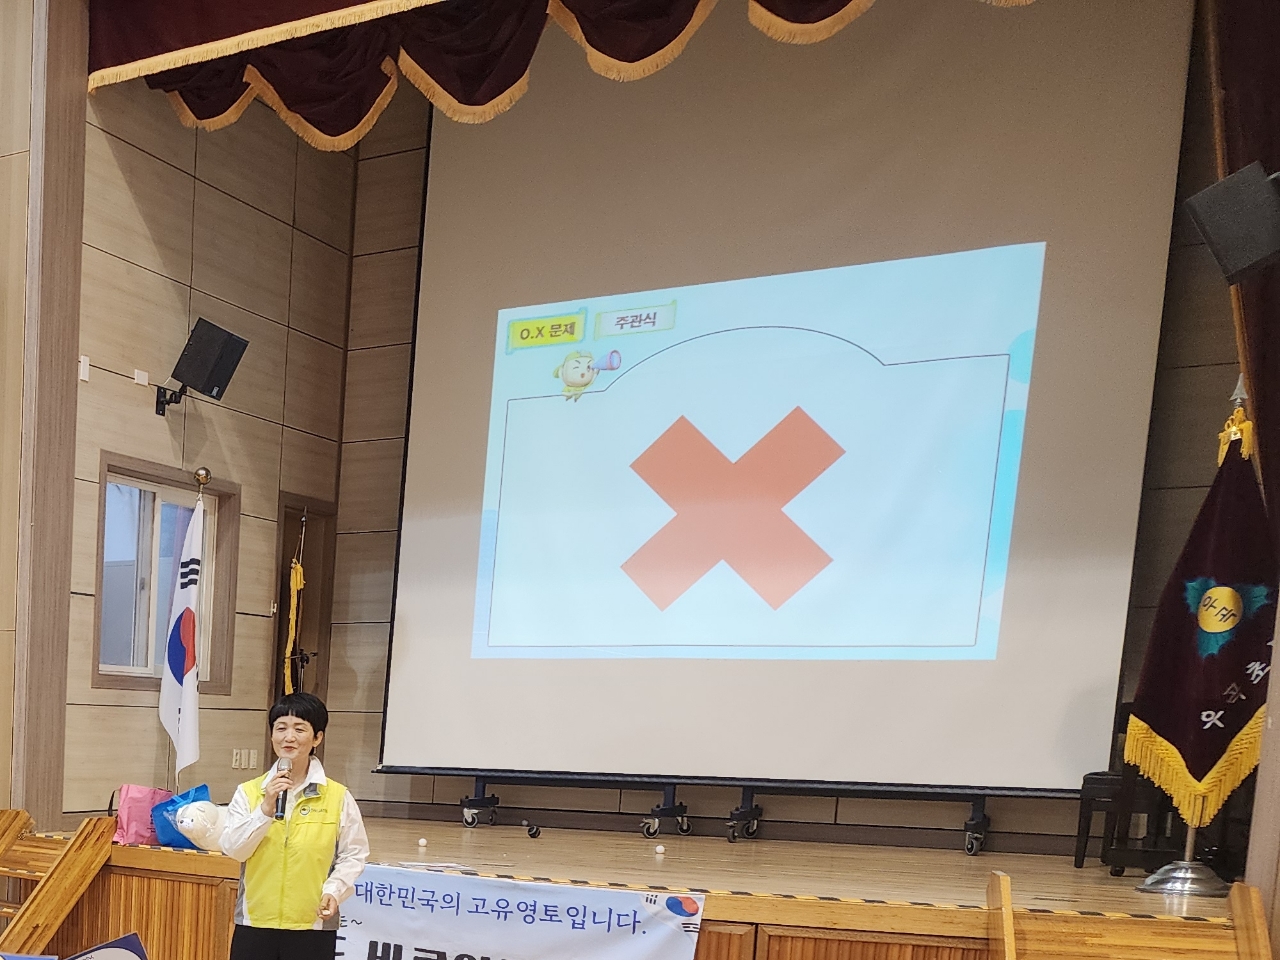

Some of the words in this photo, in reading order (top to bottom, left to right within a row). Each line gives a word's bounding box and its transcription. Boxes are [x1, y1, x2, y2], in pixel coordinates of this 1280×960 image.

[548, 321, 577, 338] 문제
[614, 312, 658, 330] 주관식
[353, 881, 461, 917] 대한민국의
[466, 897, 648, 936] 고유영토입니다.
